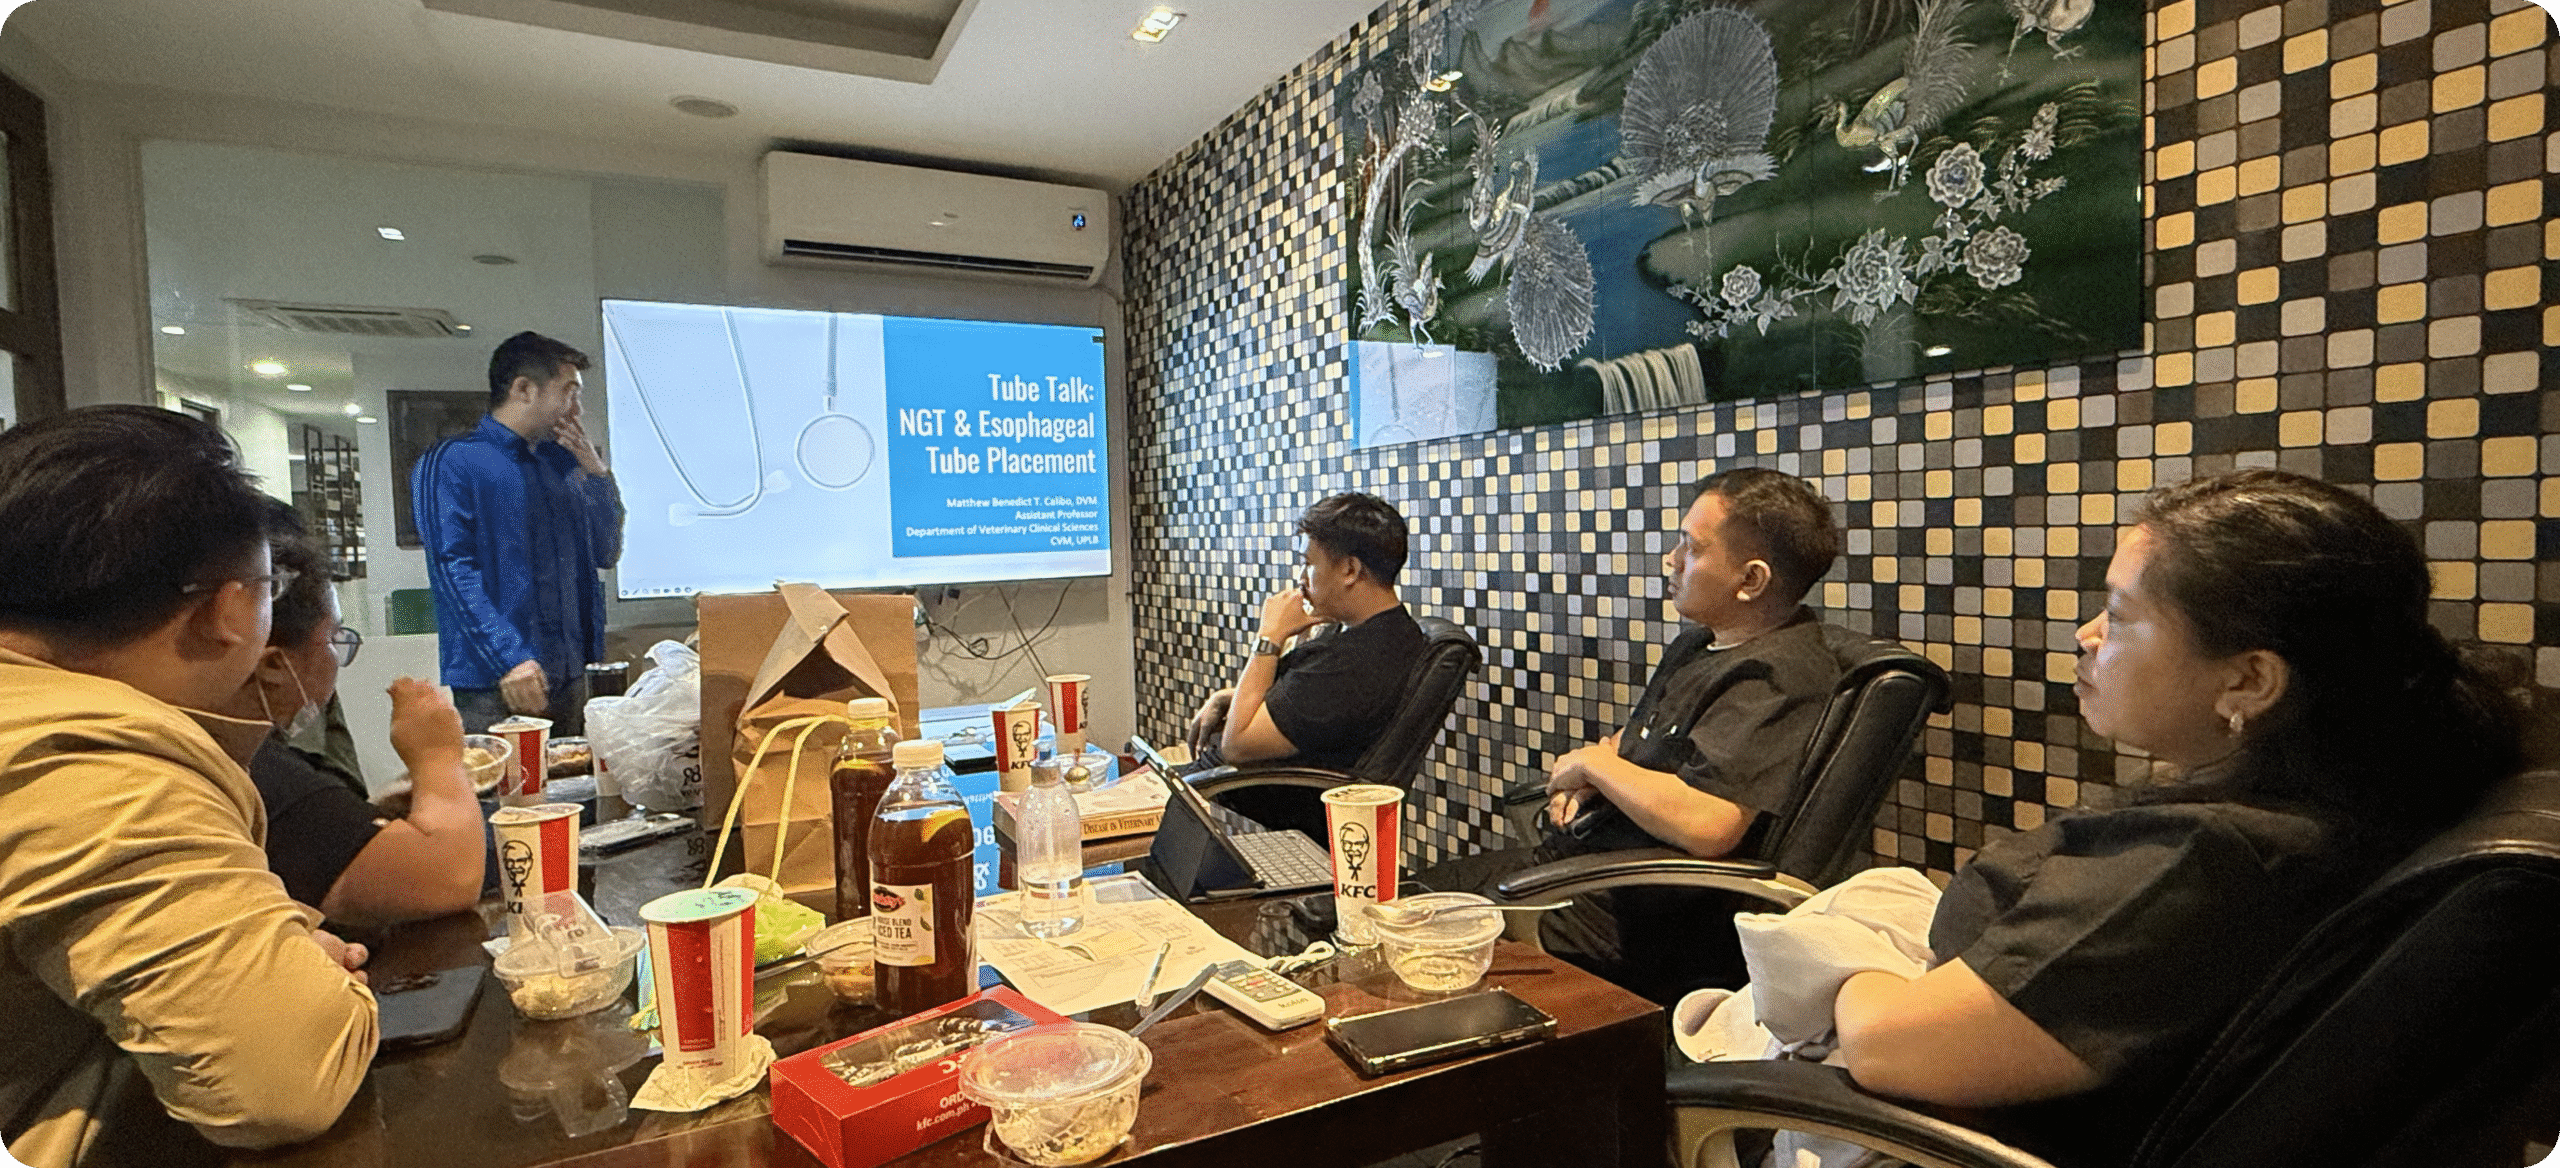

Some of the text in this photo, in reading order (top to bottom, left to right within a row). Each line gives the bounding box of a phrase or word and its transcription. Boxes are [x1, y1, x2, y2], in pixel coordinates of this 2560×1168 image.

[987, 373, 1094, 403] Tube Talk:
[899, 408, 1095, 443] NGT & Esophageal
[925, 446, 1097, 474] Tube Placement
[946, 497, 990, 507] Matthew
[992, 496, 1032, 507] Benedict
[1033, 497, 1042, 506] T.
[1075, 495, 1097, 505] DVM
[1015, 510, 1098, 520] Assistant Professor
[906, 523, 1099, 537] Department of Veterinary Clinical Sciences
[1050, 535, 1099, 546] CVM, UPLB
[1340, 883, 1376, 898] KFC
[894, 927, 912, 939] TEA
[940, 1091, 966, 1109] ORD
[916, 1102, 970, 1131] kfc.com.ph
